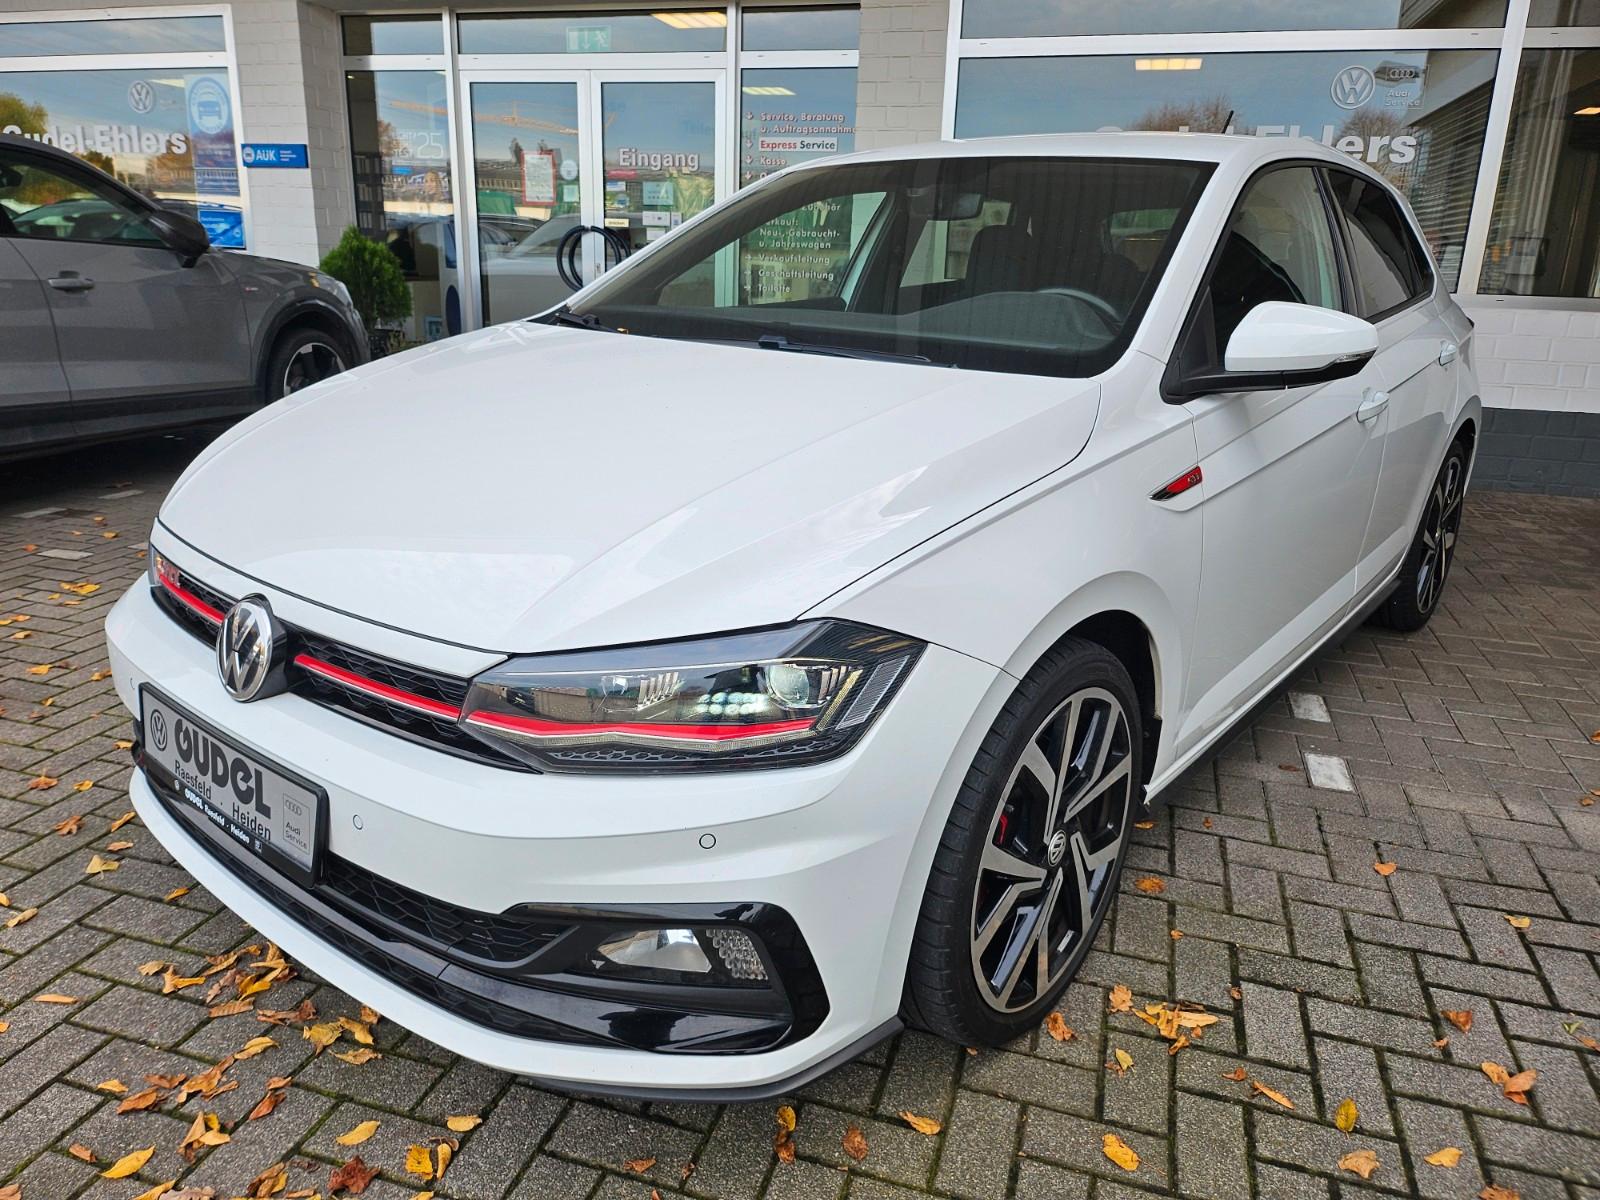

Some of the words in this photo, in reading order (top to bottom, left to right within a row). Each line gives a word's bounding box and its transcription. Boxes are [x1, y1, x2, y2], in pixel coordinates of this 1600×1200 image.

[760, 112, 798, 122] Service,
[801, 112, 845, 123] Beratung
[760, 140, 797, 151] Express
[799, 140, 836, 150] Service
[619, 148, 699, 172] Eingang
[760, 155, 787, 166] Kasse
[759, 254, 830, 266] Verkaufsleitung
[174, 759, 212, 800] Raesfeld
[232, 802, 271, 841] Heiden
[286, 821, 301, 836] Audi
[285, 830, 308, 850] Service
